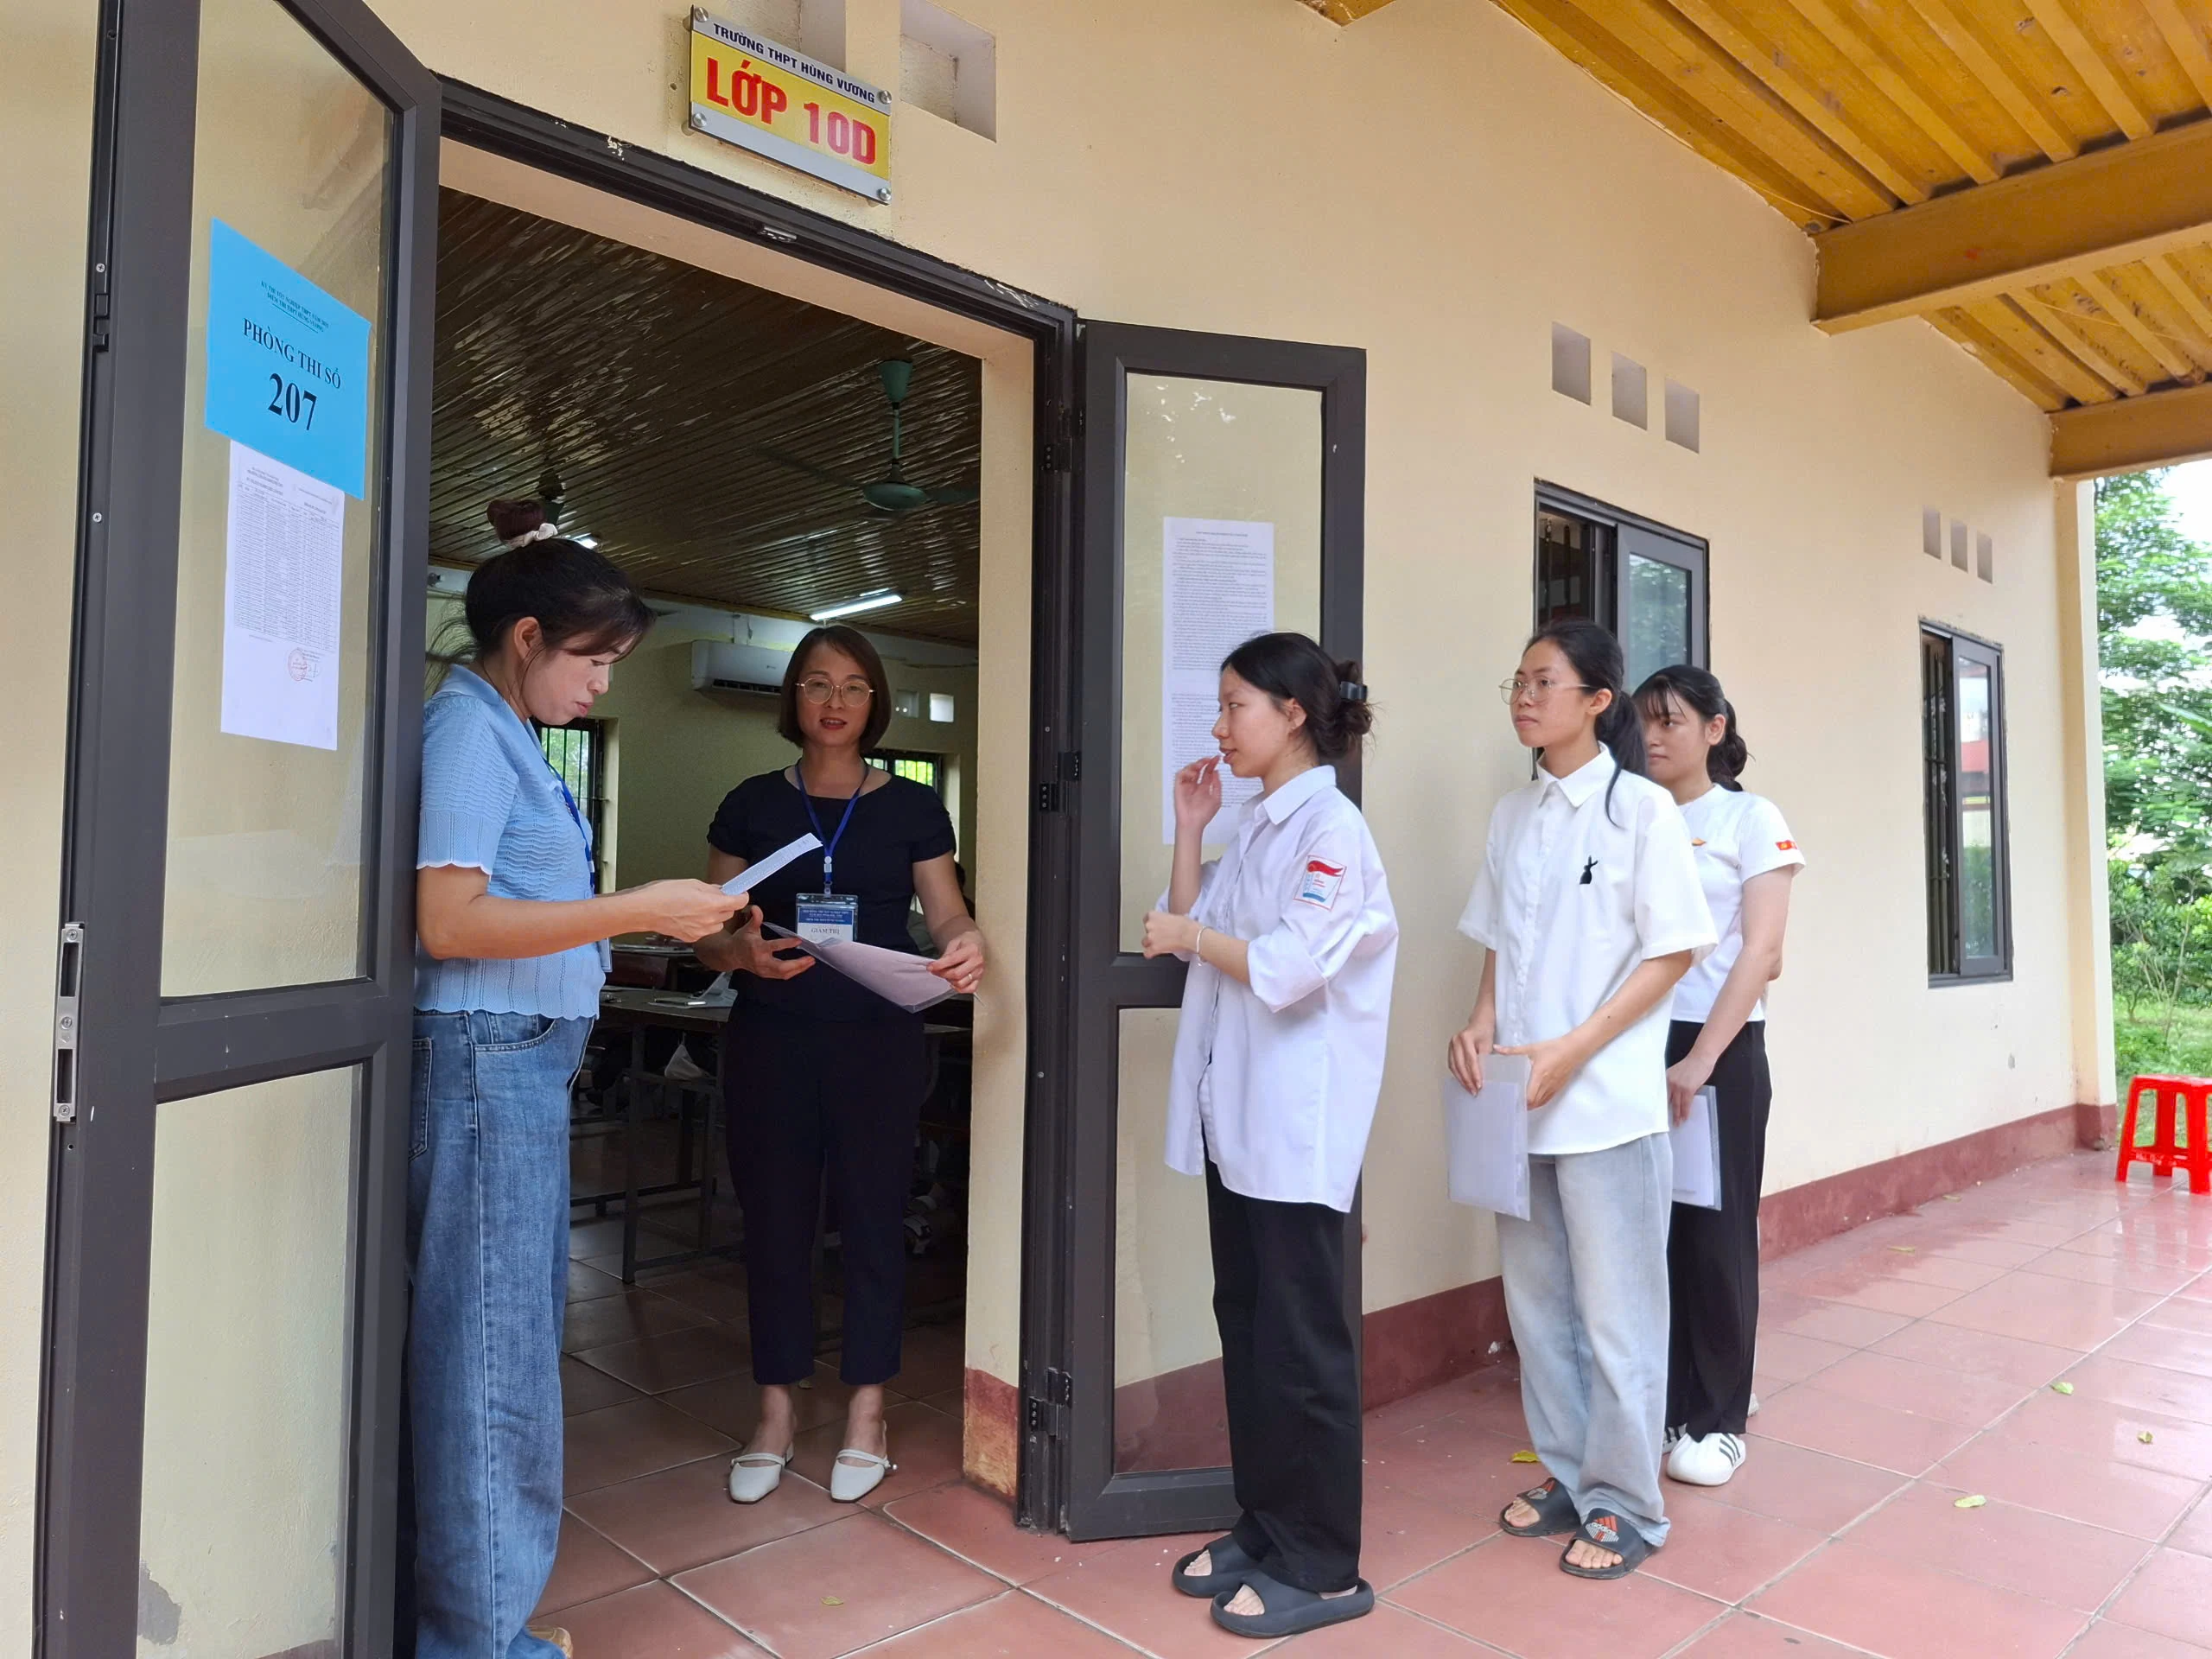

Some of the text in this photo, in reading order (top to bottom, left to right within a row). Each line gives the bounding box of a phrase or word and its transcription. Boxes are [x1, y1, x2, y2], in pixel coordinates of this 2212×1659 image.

[713, 22, 875, 104] TRƯỜNG THPT HÙNG VƯƠNG
[706, 57, 876, 165] LỚP 10D
[244, 317, 341, 390] PHÒNG THI SỐ
[268, 372, 317, 431] 207
